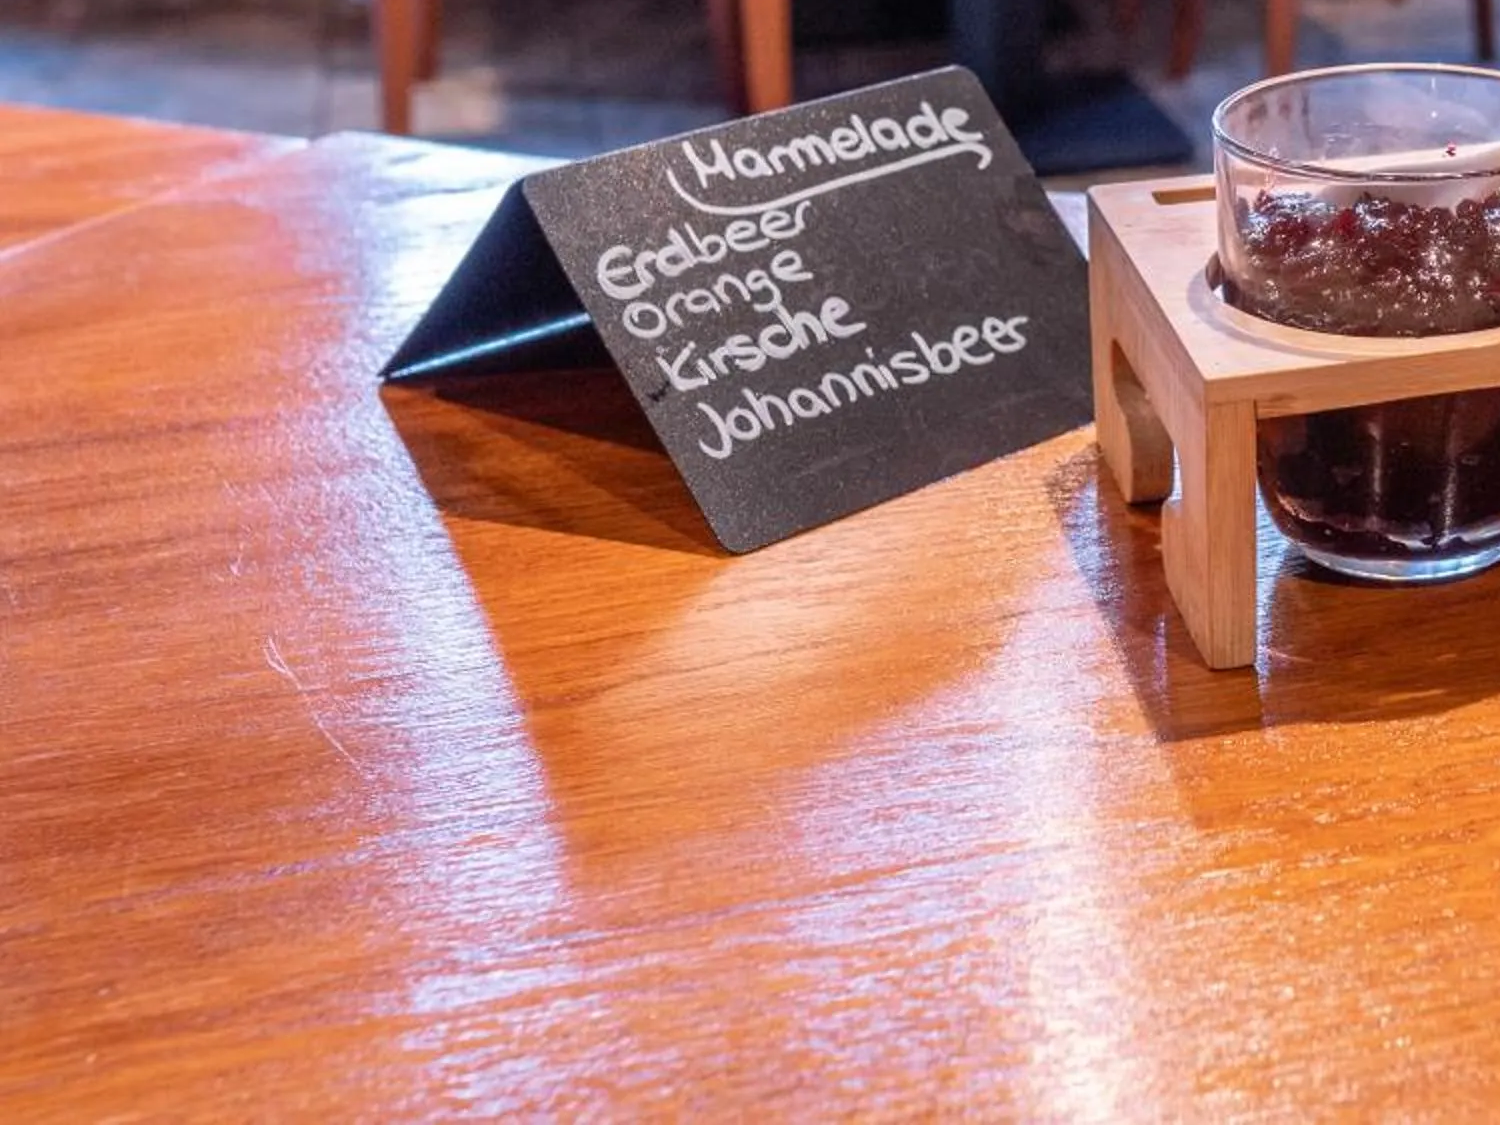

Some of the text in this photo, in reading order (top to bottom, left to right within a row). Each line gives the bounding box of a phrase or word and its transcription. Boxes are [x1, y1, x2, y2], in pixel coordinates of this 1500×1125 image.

[682, 101, 983, 189] Marmelade
[596, 199, 811, 300] Erdbeer
[622, 249, 813, 339] Orange
[656, 296, 867, 392] Kirsche
[698, 315, 1029, 459] Johannisbeer
